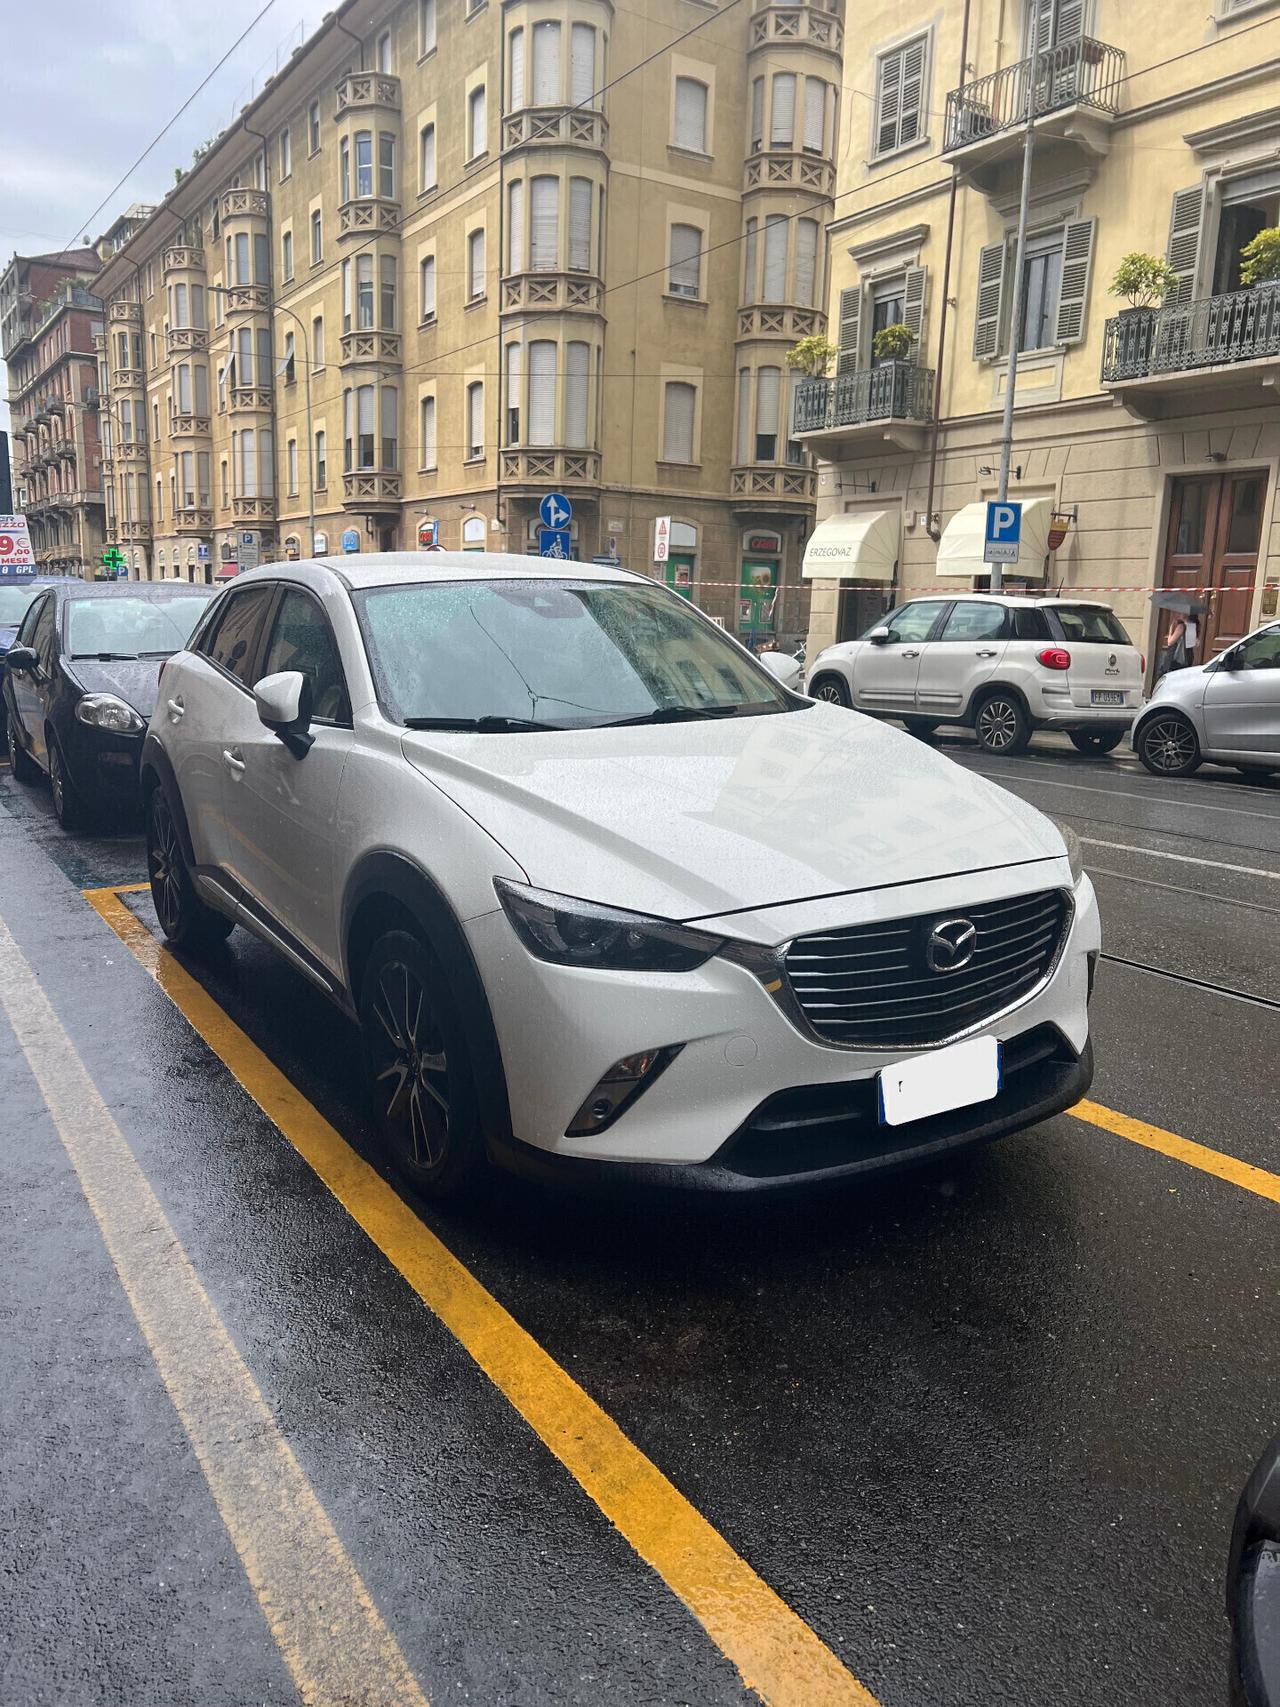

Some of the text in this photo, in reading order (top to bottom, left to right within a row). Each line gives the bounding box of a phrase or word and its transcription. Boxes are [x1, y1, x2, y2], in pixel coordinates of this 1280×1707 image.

[993, 506, 1015, 538] P
[809, 546, 852, 557] ERZEGOVAZ
[15, 565, 34, 574] GPL
